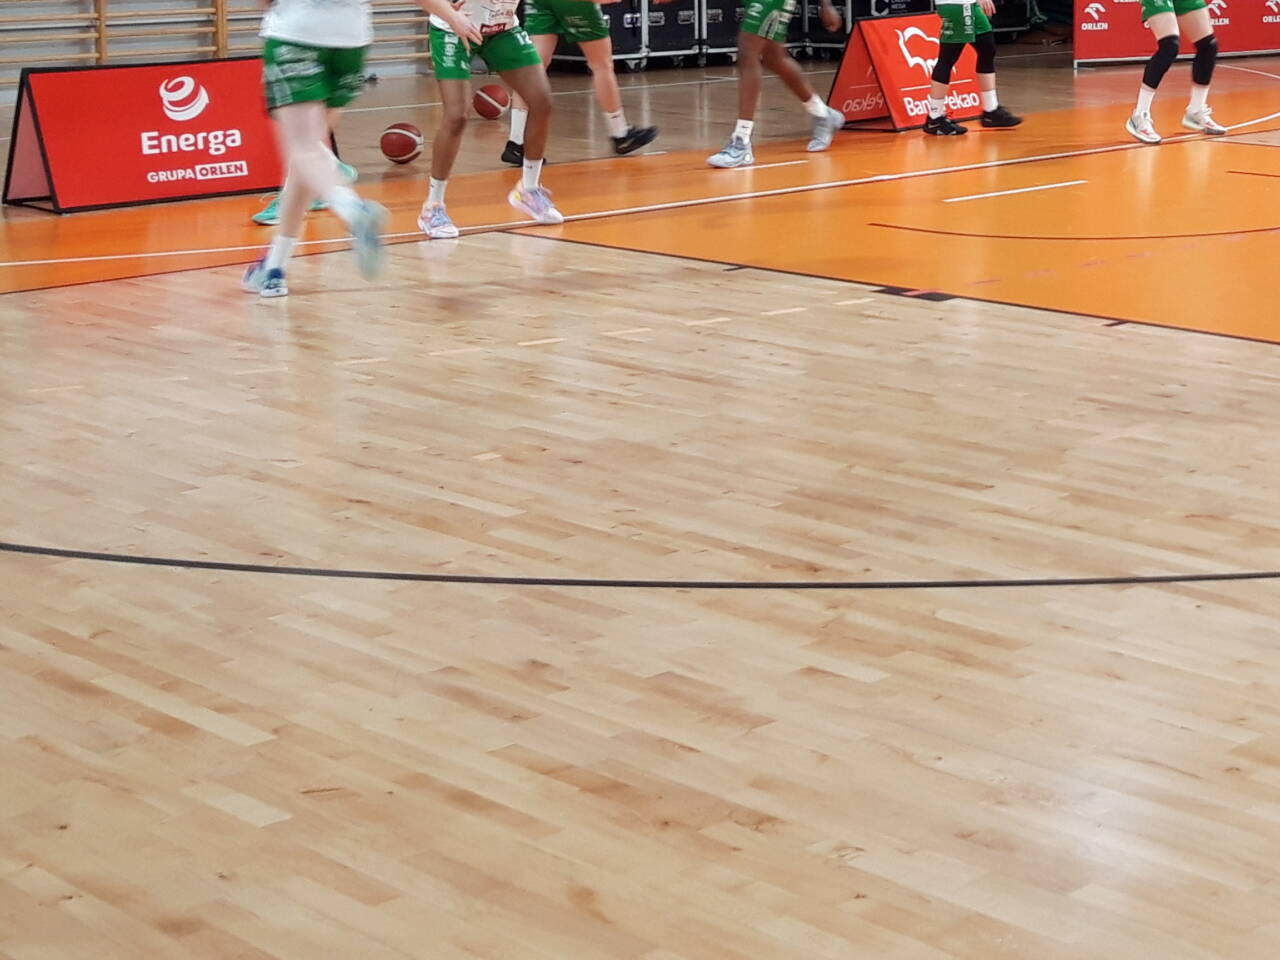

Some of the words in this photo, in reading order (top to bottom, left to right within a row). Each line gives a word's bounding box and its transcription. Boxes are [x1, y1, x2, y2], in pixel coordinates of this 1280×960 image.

[1210, 18, 1229, 26] RLEN
[141, 129, 242, 155] Energa
[147, 168, 196, 183] GRUPA
[199, 163, 244, 177] ORLEN
